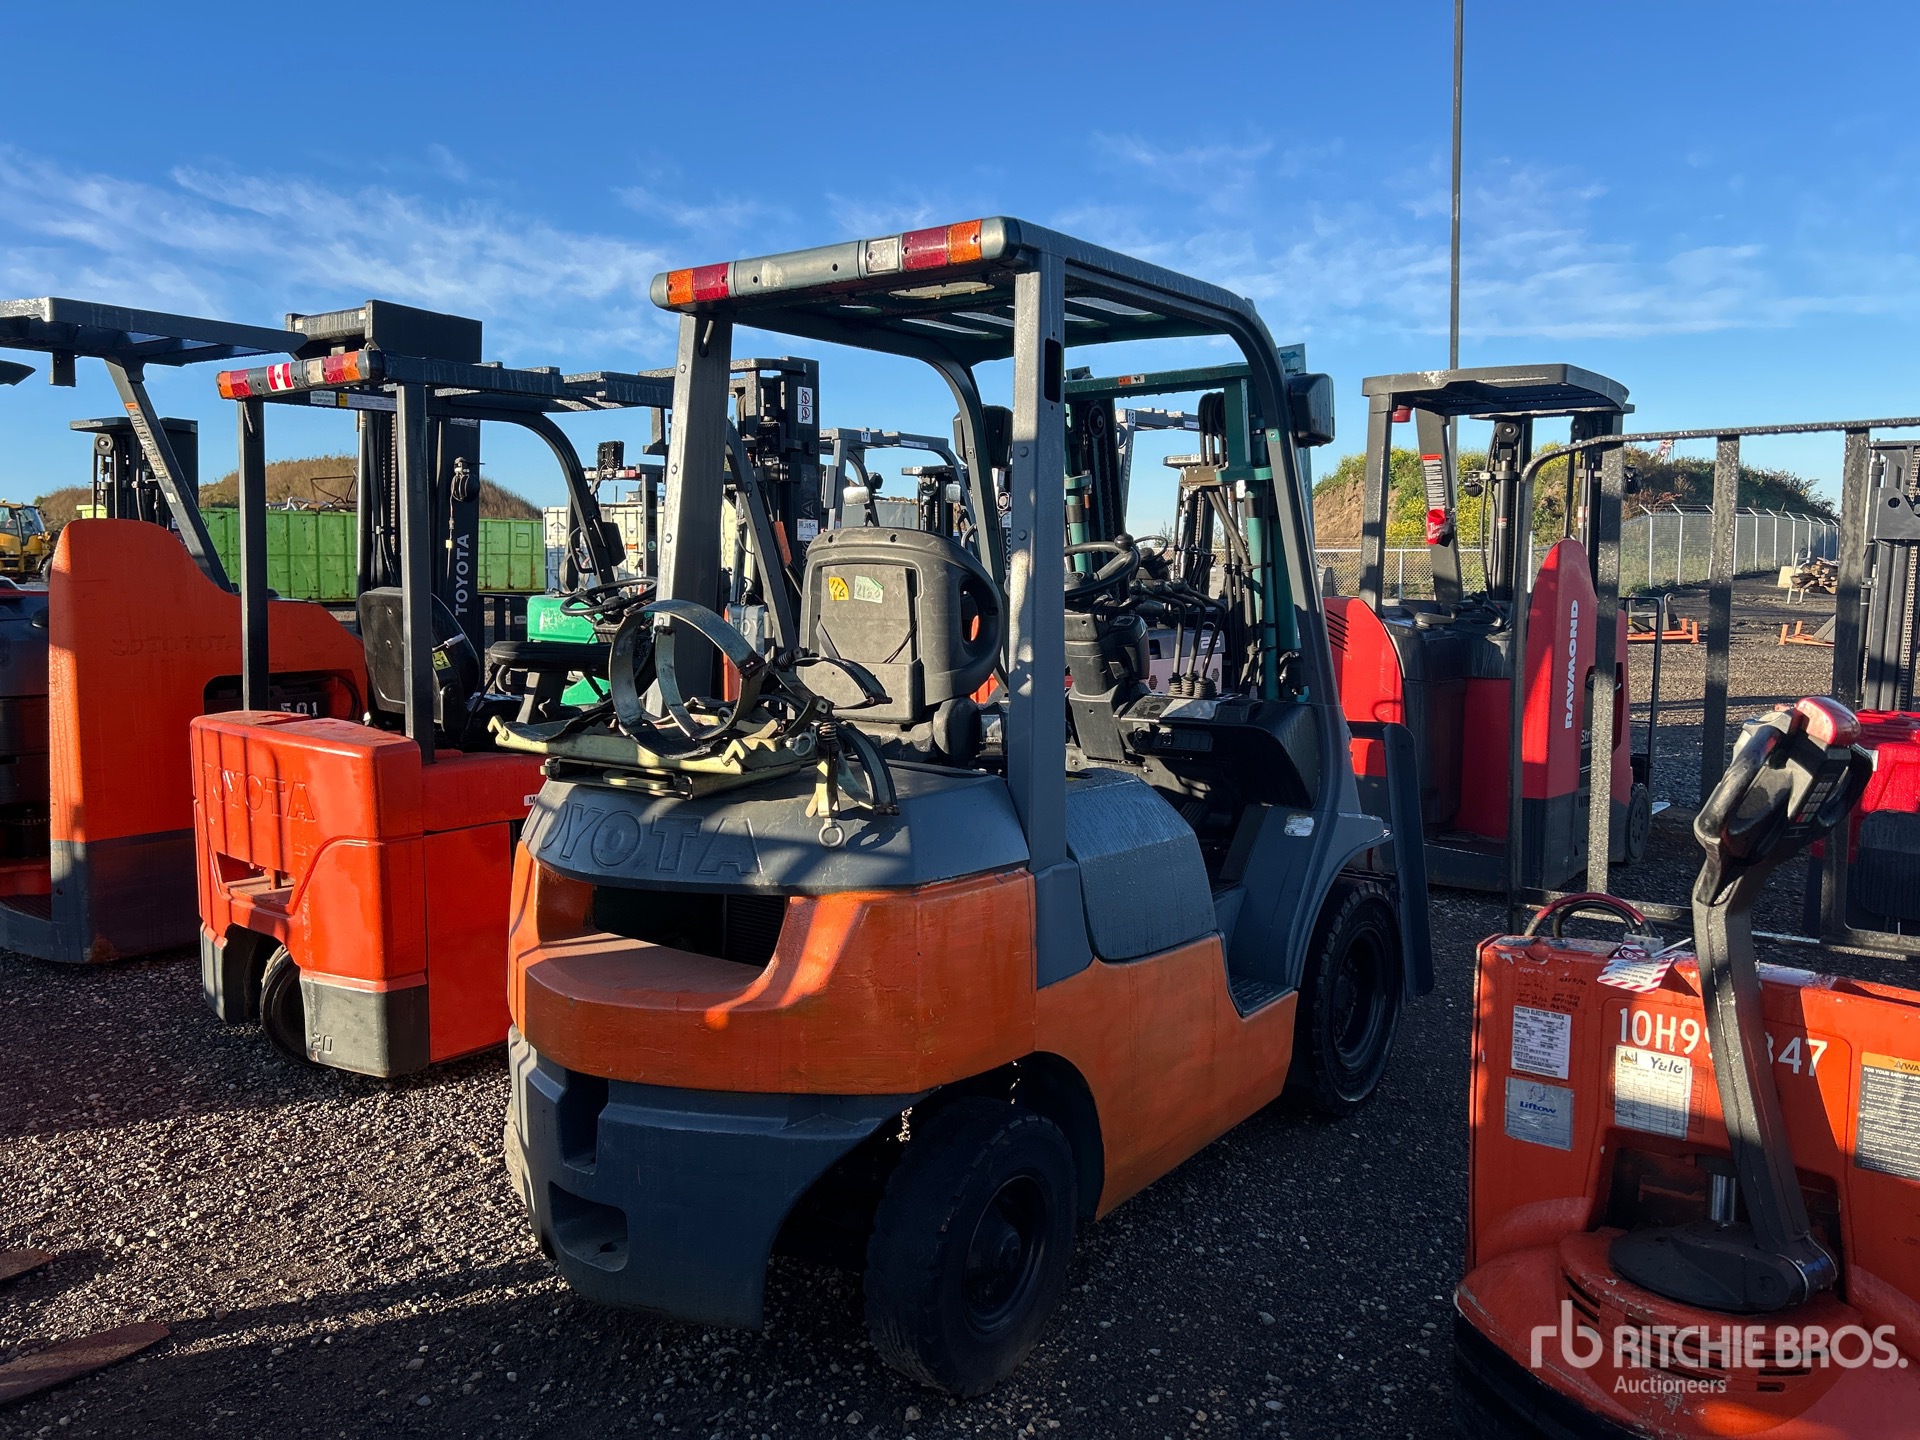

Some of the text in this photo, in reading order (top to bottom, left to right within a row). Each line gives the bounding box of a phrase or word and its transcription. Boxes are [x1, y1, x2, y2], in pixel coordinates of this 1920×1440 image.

[861, 431, 870, 441] 17
[455, 533, 470, 616] TOYOTA
[1565, 599, 1578, 729] RAYMOND
[203, 760, 317, 823] TOYOTA
[522, 799, 765, 876] TOYOTA
[1519, 1100, 1557, 1114] Liftow
